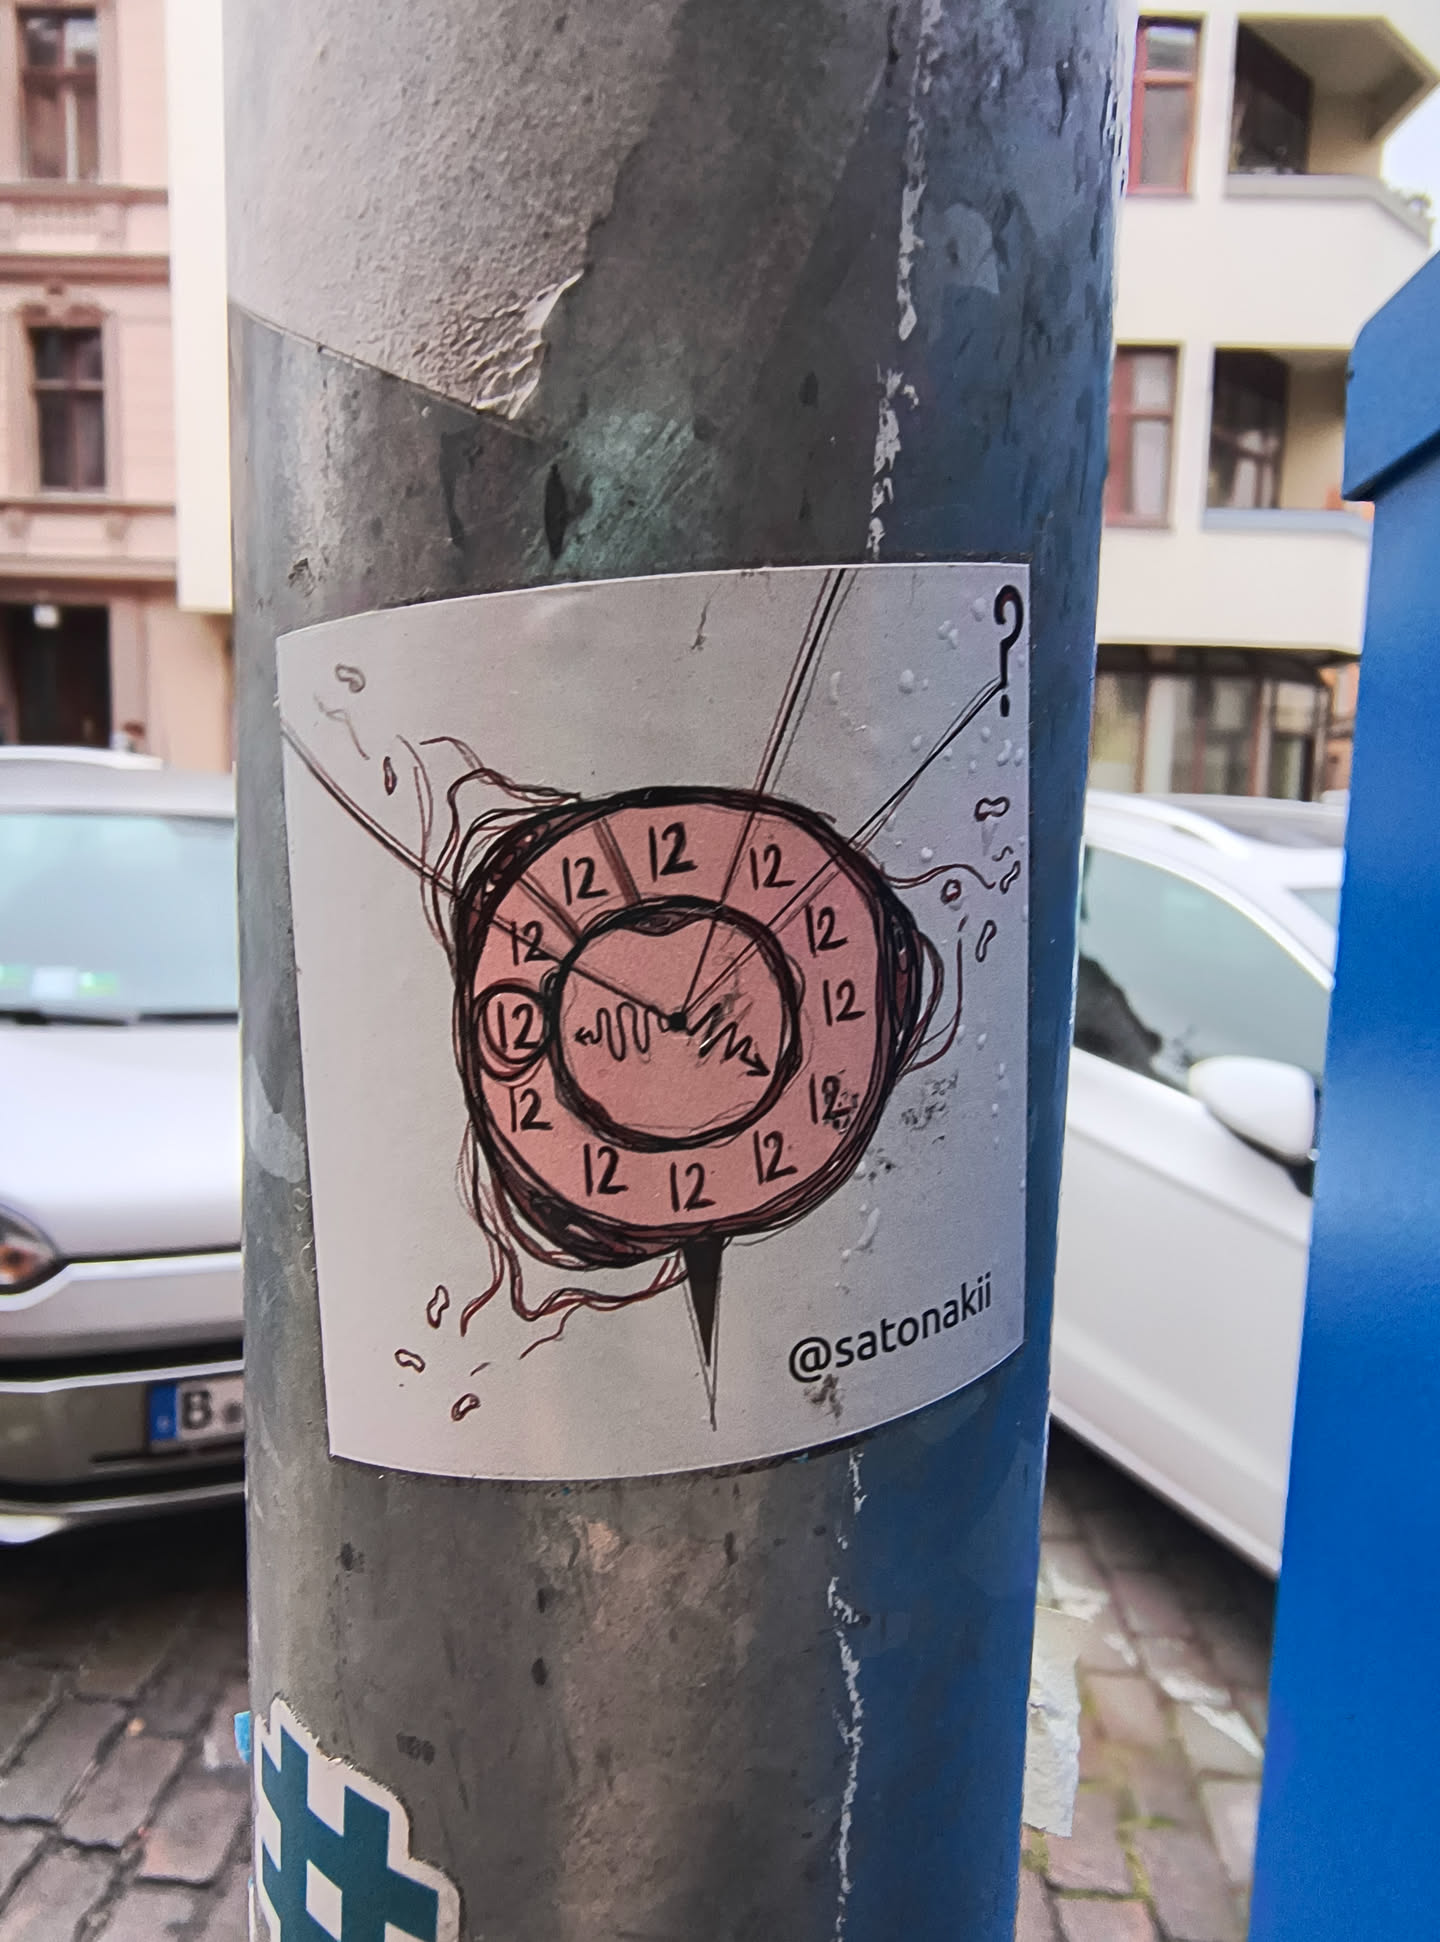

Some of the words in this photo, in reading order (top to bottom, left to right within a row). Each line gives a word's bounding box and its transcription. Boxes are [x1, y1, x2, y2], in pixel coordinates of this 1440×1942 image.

[648, 822, 698, 882] 12
[750, 844, 796, 890] 12
[562, 856, 608, 905] 12
[511, 919, 551, 966] 12
[805, 906, 848, 958] 12
[497, 1001, 541, 1051] 12
[823, 978, 866, 1026] 12
[510, 1087, 553, 1133] 12
[808, 1074, 852, 1124] 12
[584, 1143, 629, 1197] 12
[753, 1130, 798, 1185] 12
[670, 1162, 716, 1212] 12
[789, 1271, 992, 1383] @satonakii
